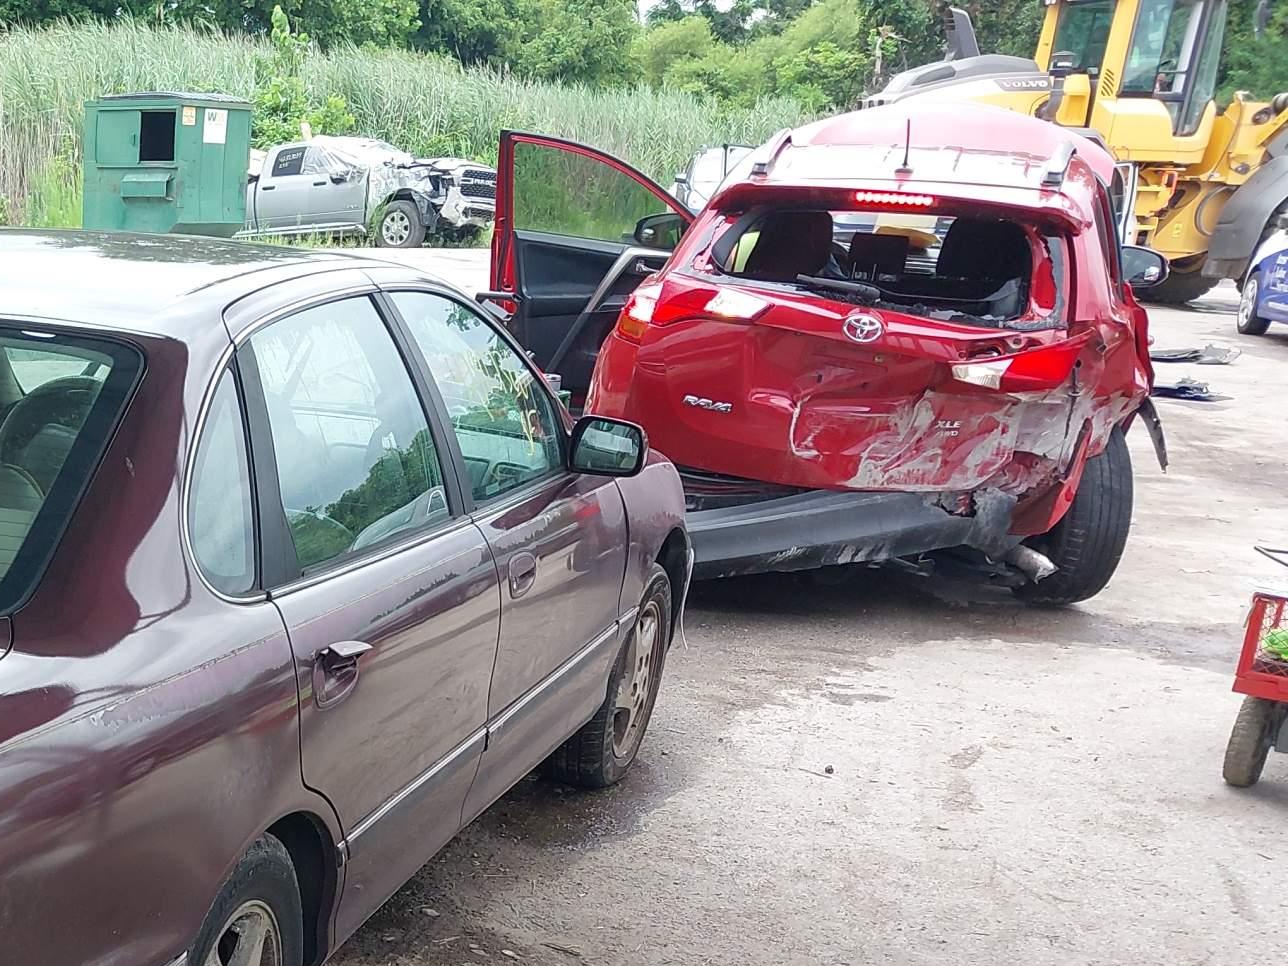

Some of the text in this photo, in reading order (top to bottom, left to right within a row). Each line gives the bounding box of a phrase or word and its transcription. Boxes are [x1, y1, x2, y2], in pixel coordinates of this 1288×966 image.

[1002, 80, 1049, 88] VOLVO
[682, 395, 733, 413] RAV4
[935, 420, 961, 429] XLE
